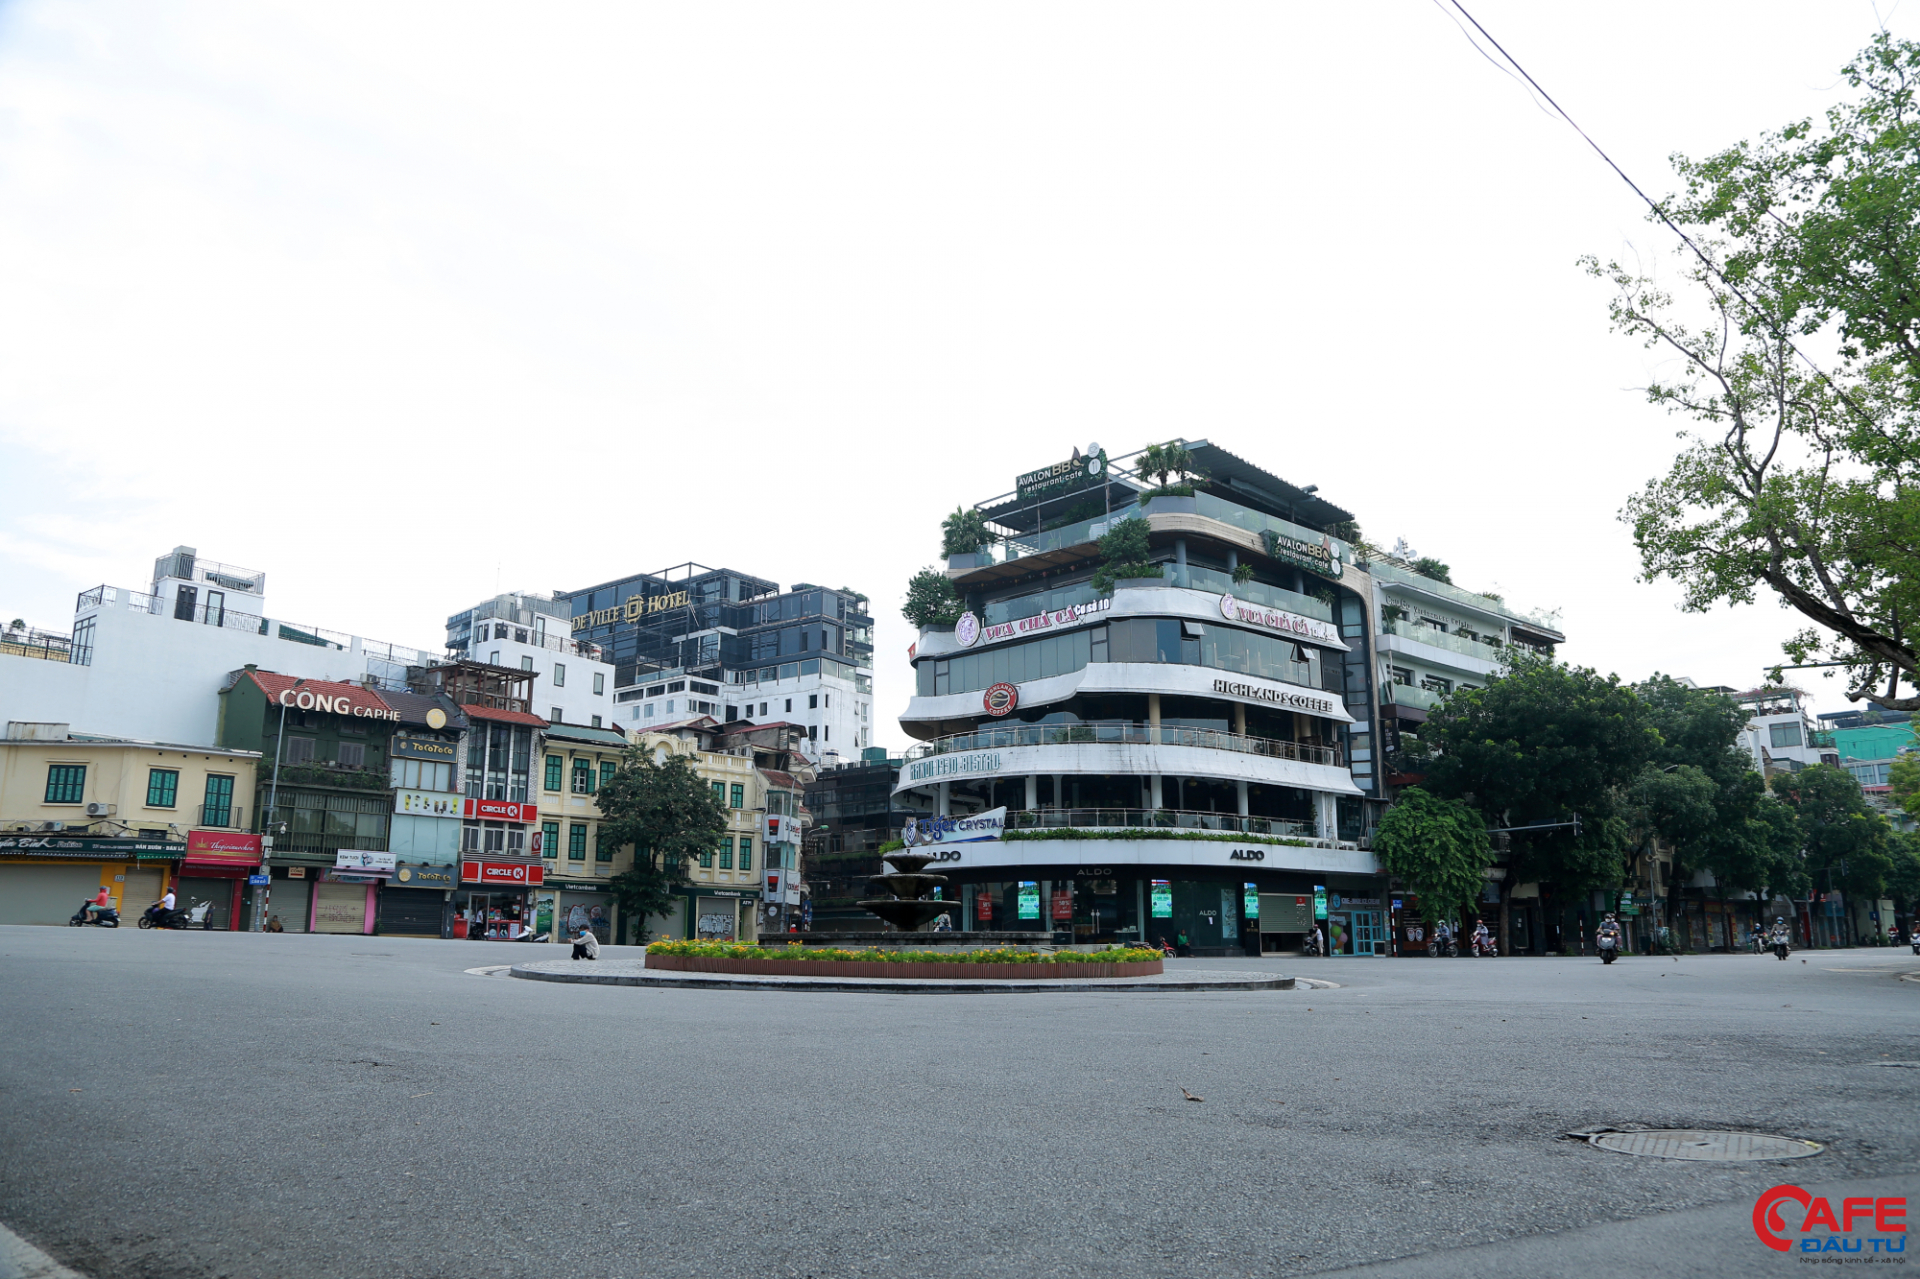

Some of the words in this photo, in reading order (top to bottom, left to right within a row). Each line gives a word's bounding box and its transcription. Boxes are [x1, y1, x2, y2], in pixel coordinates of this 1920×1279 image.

[1018, 469, 1051, 487] AVALON
[1277, 536, 1308, 553] AVALON
[572, 615, 586, 632] DE
[588, 606, 620, 627] VILLE
[648, 590, 690, 614] HOTEL
[985, 622, 1016, 640] VUA
[1019, 610, 1052, 633] CHẢ
[1055, 604, 1078, 624] CÁ
[1098, 598, 1110, 612] 10
[1237, 606, 1264, 625] VUA
[1265, 612, 1292, 632] CHẢ
[985, 684, 1015, 700] HIGHLANDS
[1214, 679, 1290, 704] HIGHLANDS
[1291, 694, 1333, 712] COFFEE
[989, 704, 1012, 715] COFFEE
[910, 760, 934, 780] HANOI
[961, 752, 1000, 772] BISTRO
[481, 805, 506, 814] CIRCLE
[507, 805, 518, 817] K
[920, 814, 957, 840] Tiger
[958, 818, 1005, 831] CRYSTAL
[927, 850, 962, 862] LDO
[1230, 849, 1264, 861] ALDO
[486, 868, 512, 876] CIRCLE
[513, 867, 524, 879] K
[1076, 868, 1112, 876] ALDO
